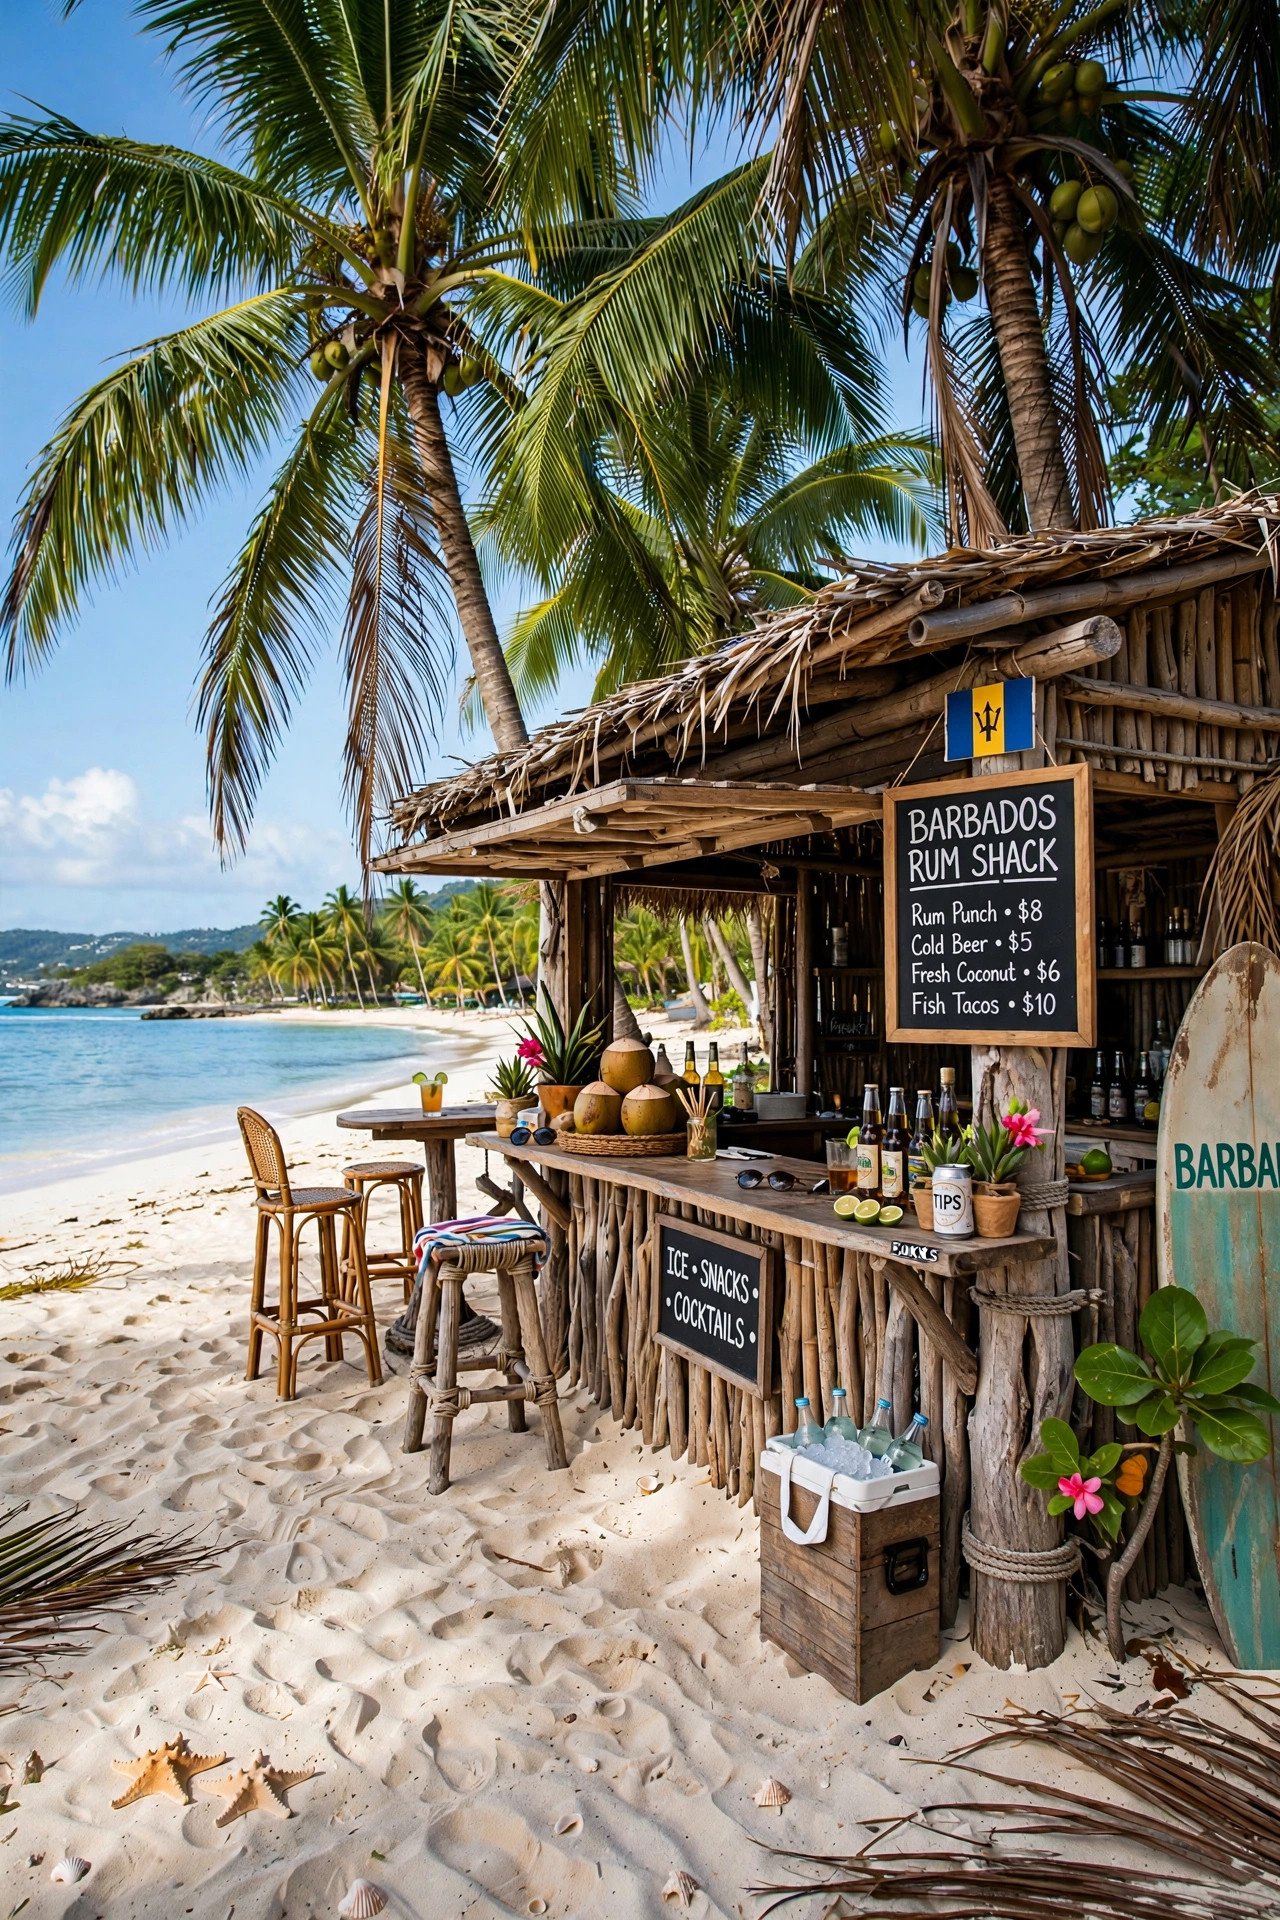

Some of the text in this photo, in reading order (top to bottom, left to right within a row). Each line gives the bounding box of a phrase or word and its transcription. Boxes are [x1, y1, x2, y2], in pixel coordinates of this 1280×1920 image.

[908, 794, 1057, 844] BARBADOS
[908, 837, 1058, 882] RUM SHACK
[912, 898, 1043, 926] Rum Punch $8
[911, 930, 1032, 956] Cold Beer $5
[912, 959, 1060, 983] Fresh Coconut $6
[912, 991, 1056, 1016] Fish Tacos $10
[1174, 1142, 1280, 1189] BARBA
[933, 1193, 962, 1210] TIPS
[666, 1246, 749, 1304] ICE SNACKS
[674, 1291, 745, 1349] COCKTAILS
